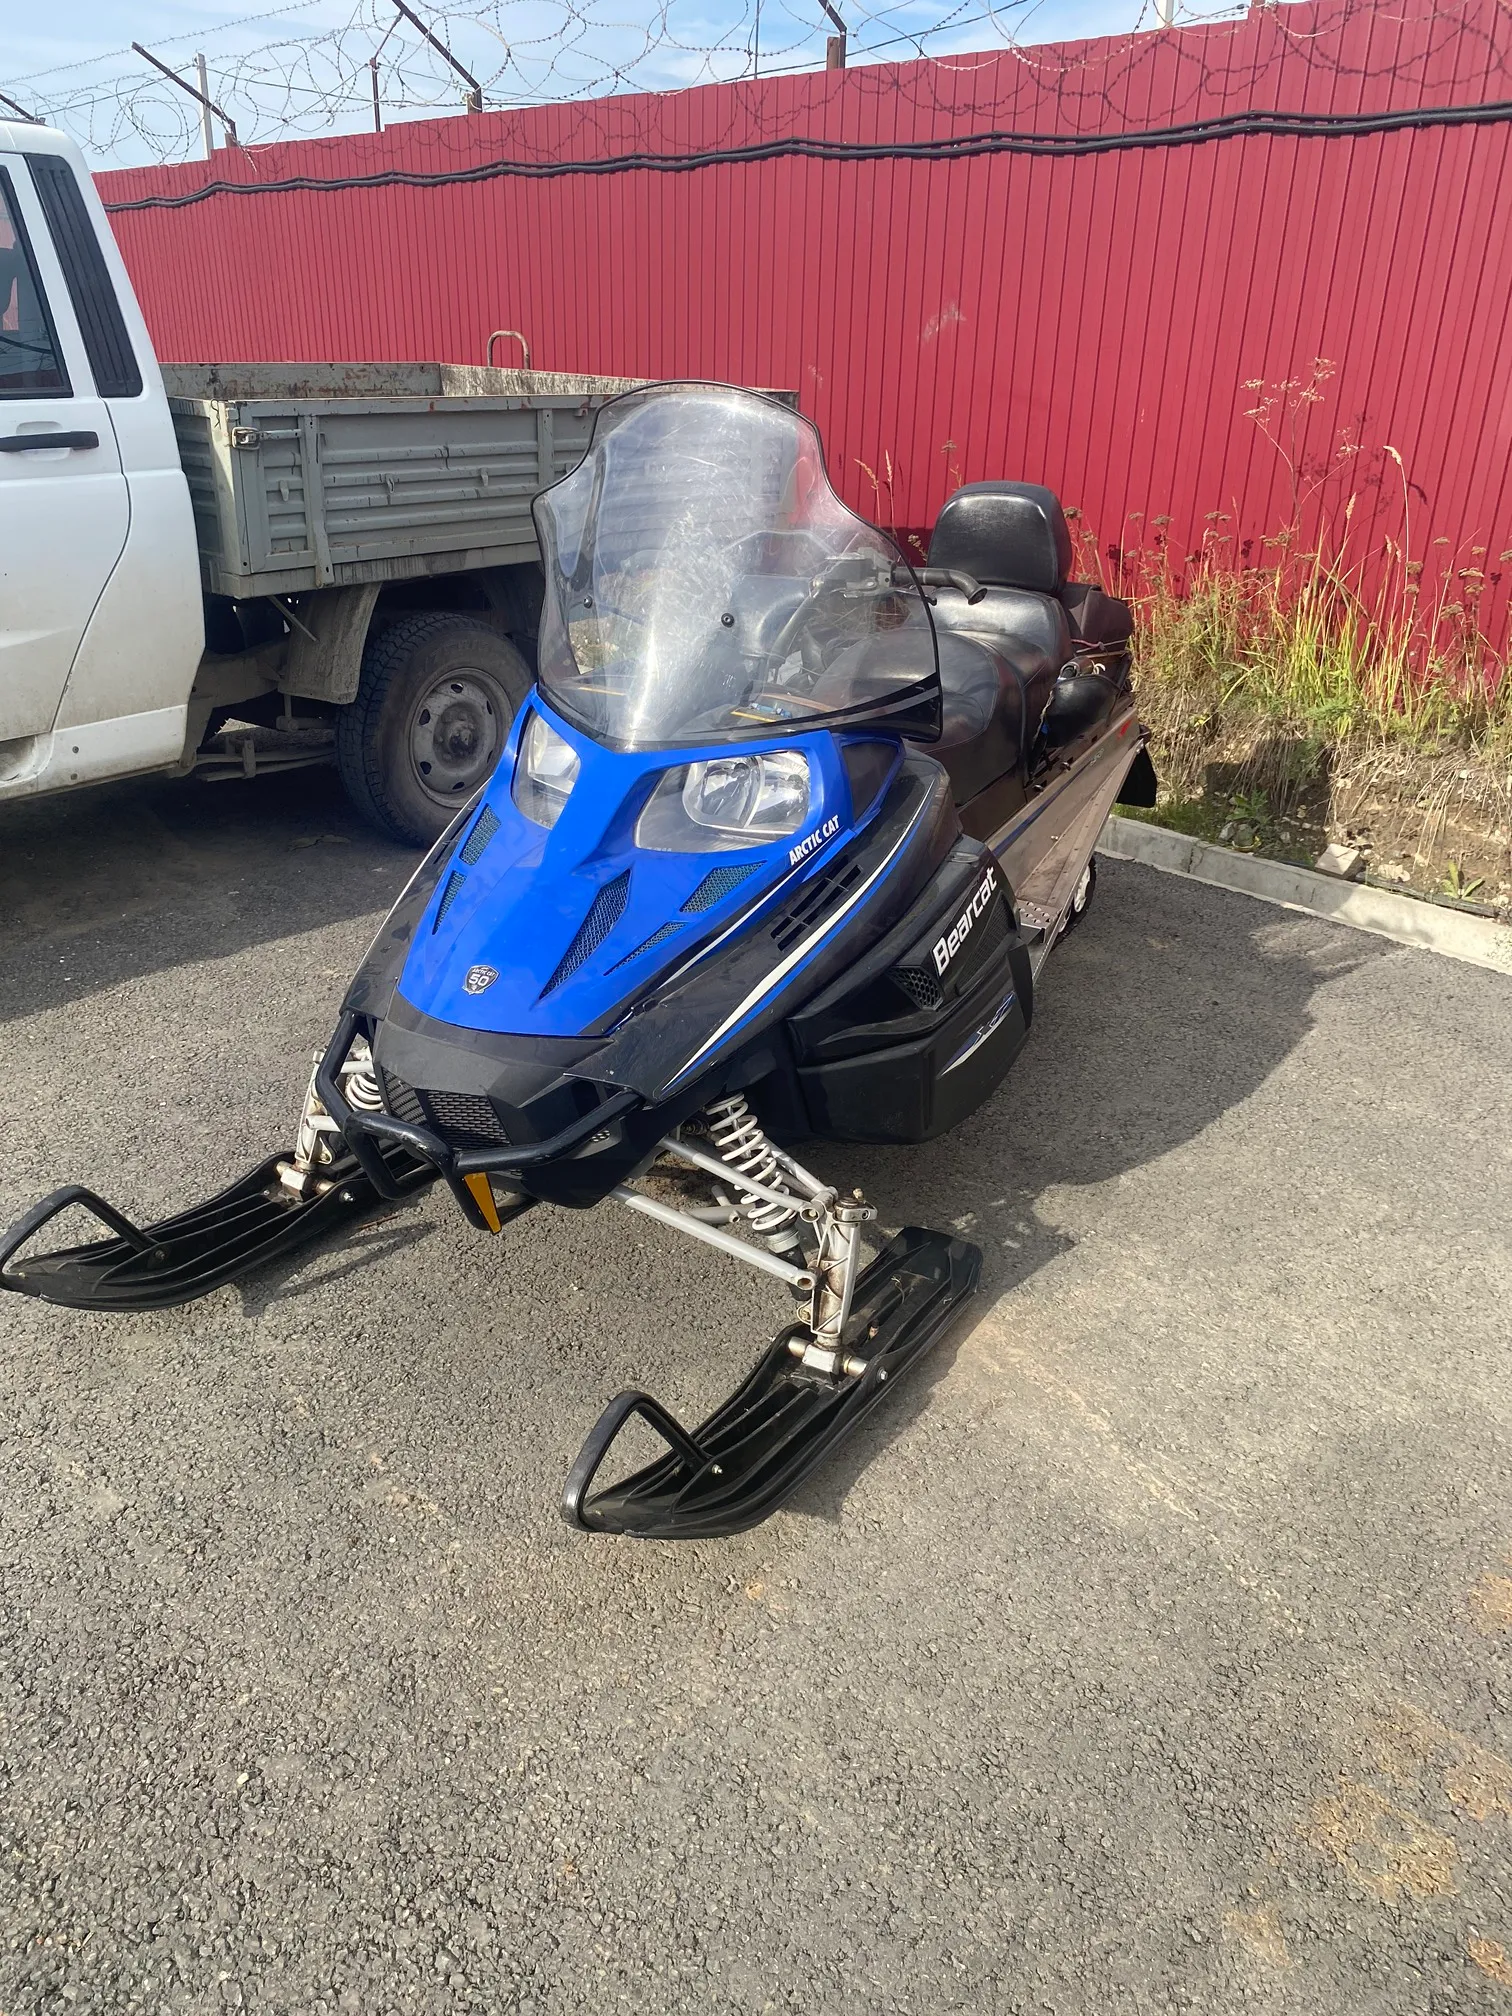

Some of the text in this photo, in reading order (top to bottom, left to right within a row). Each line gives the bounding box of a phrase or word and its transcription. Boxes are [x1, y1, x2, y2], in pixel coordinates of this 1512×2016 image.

[789, 814, 839, 866] ARCTIC CAT
[933, 866, 997, 977] Bearcat
[468, 973, 490, 987] 50
